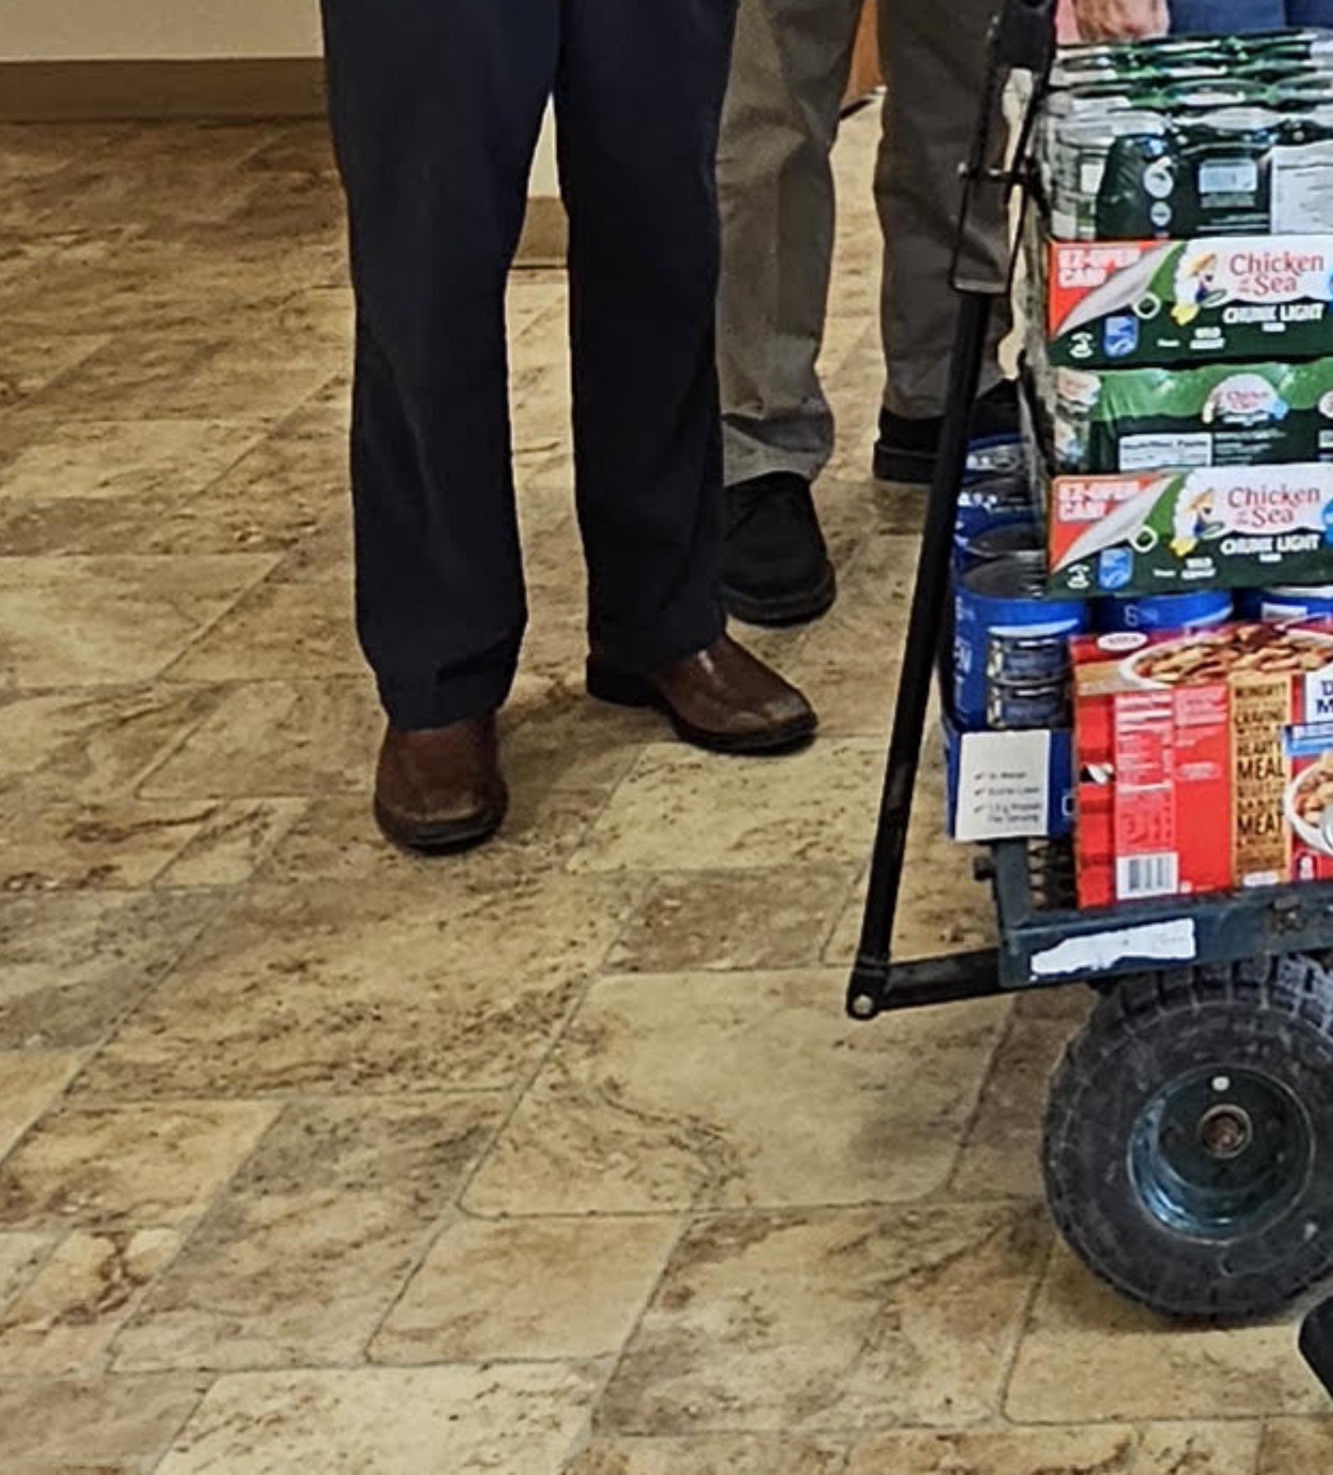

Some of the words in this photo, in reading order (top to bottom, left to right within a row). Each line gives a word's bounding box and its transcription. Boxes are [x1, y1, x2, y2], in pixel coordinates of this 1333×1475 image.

[1229, 250, 1324, 276] Chicken
[1255, 275, 1297, 296] Sea
[1280, 303, 1325, 321] LIGHT
[1227, 484, 1321, 510] Chicken
[1252, 507, 1295, 527] Sea
[1276, 533, 1321, 552] LIGHT
[1237, 758, 1285, 781] MEAL
[1237, 814, 1284, 836] MEAT
